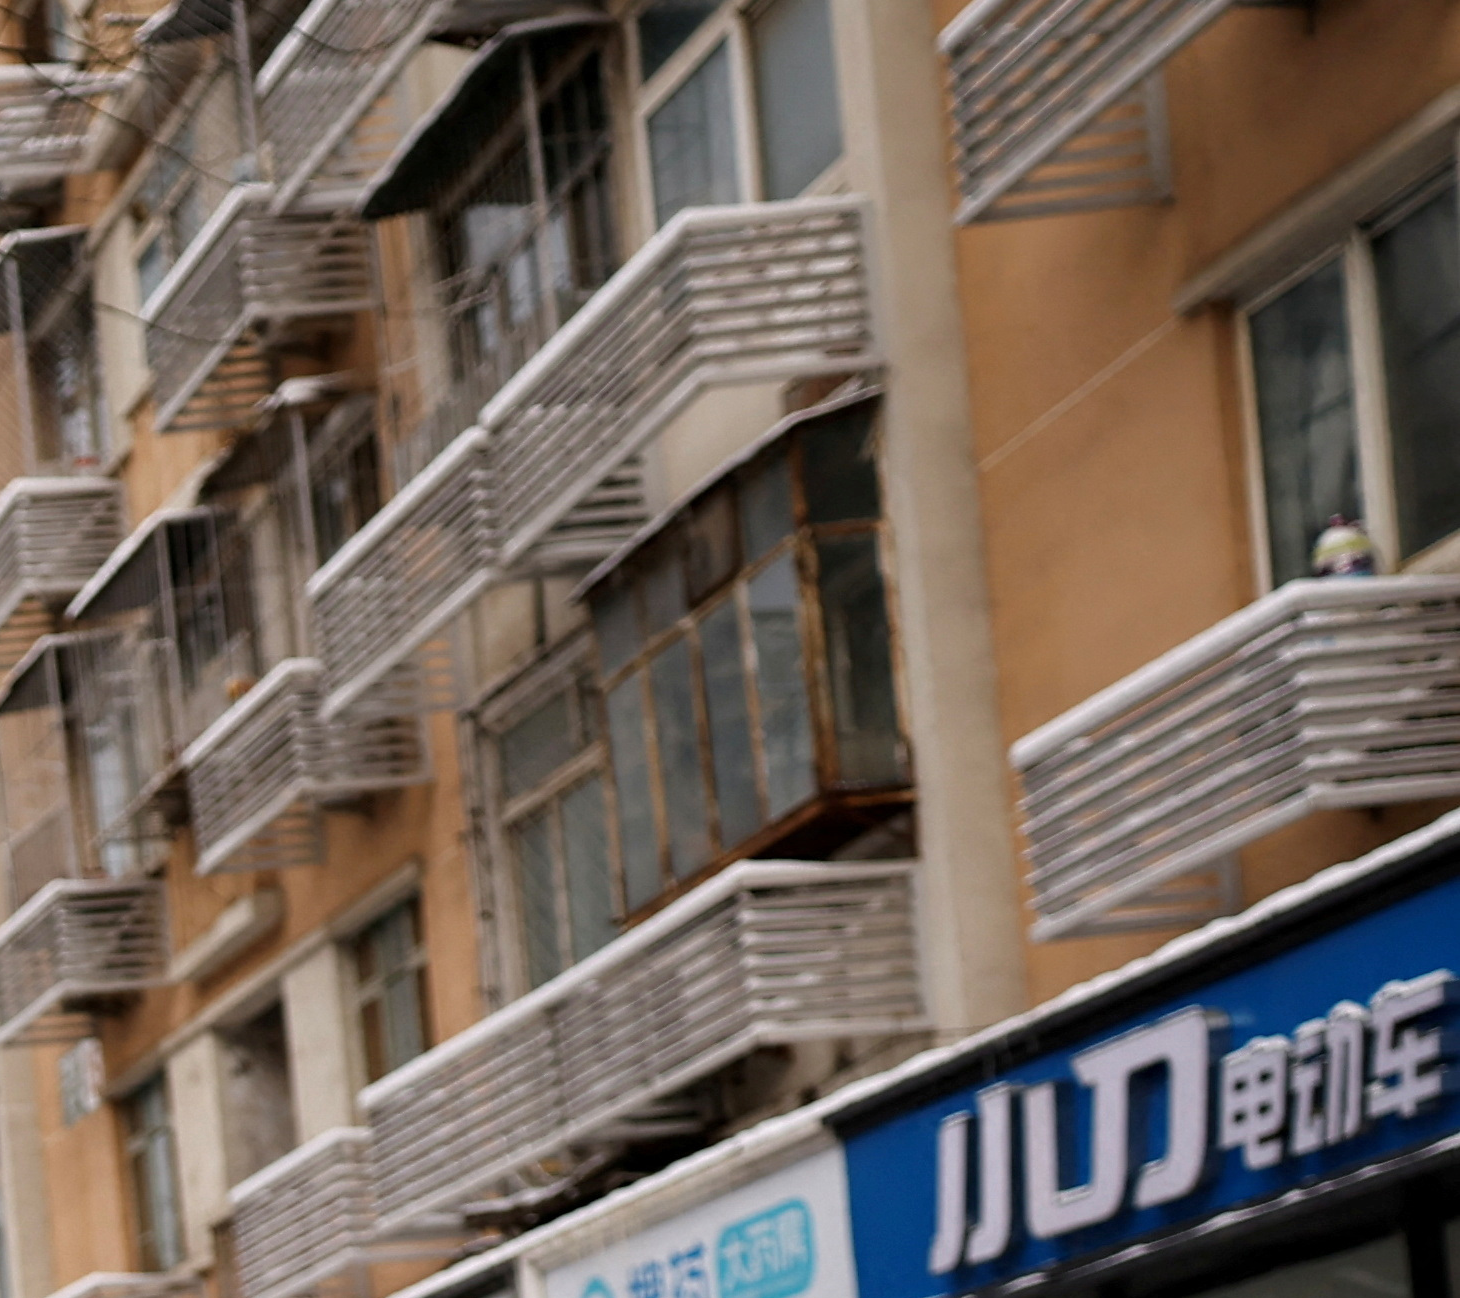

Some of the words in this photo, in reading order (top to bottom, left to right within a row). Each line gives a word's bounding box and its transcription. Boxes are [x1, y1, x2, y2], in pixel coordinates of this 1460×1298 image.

[928, 1003, 1209, 1275] 小刀
[1219, 968, 1456, 1171] 电动车
